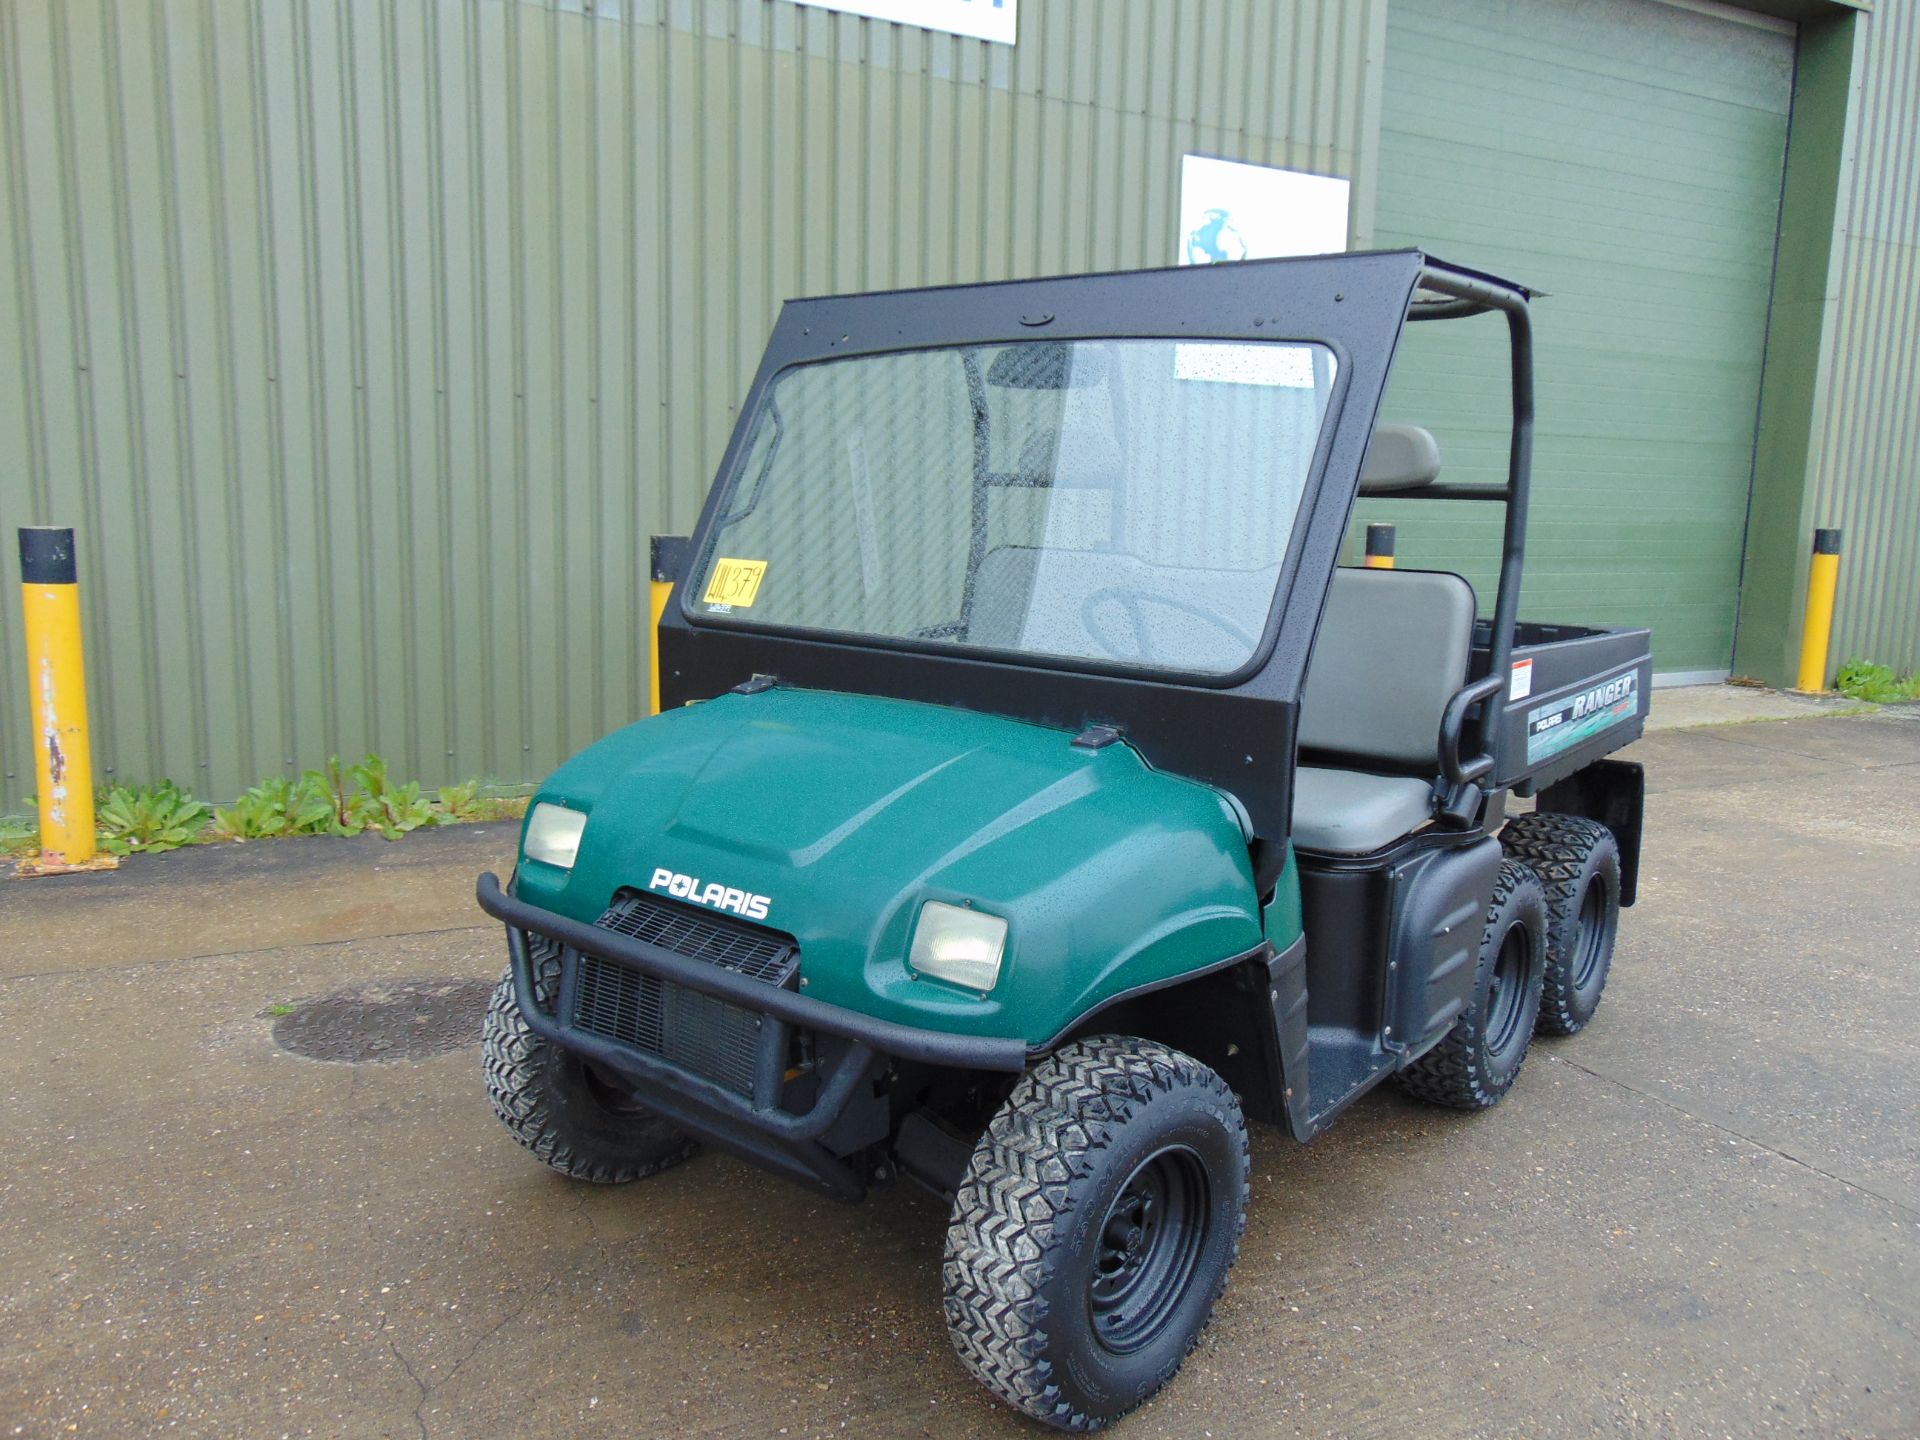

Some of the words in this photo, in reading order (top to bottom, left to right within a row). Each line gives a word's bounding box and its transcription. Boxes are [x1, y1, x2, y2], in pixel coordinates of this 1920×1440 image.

[1536, 713, 1562, 732] POLARIS
[1571, 675, 1632, 720] RANGER
[650, 868, 771, 920] POLARIS
